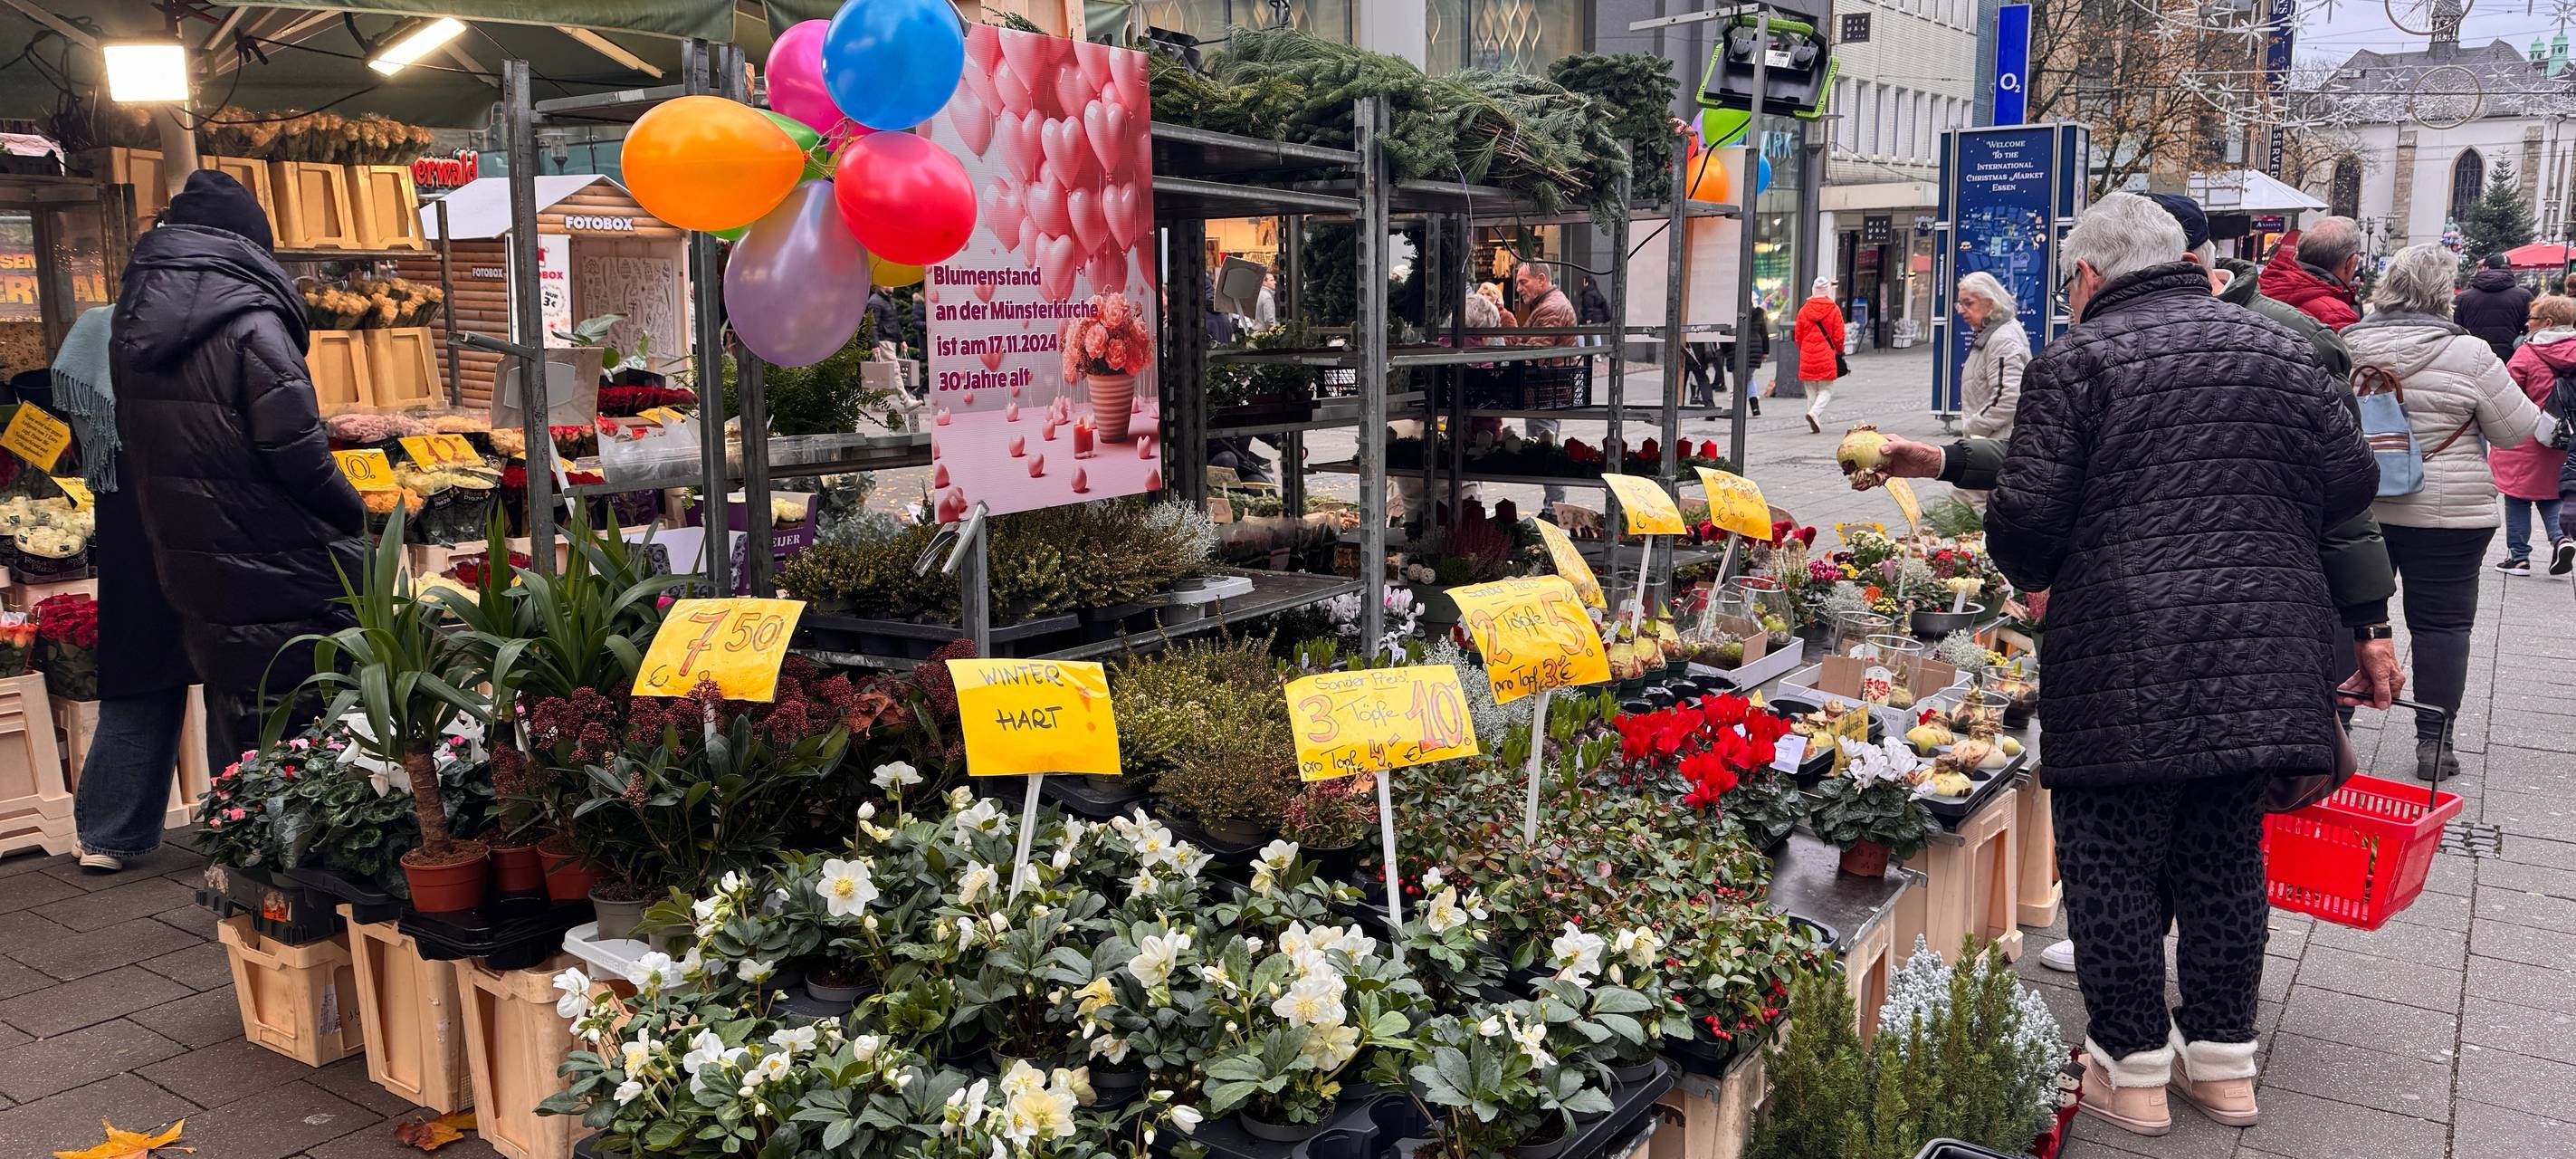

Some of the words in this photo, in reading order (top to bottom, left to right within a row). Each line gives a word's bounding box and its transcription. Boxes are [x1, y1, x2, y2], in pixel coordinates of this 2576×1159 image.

[2270, 123, 2282, 177] ESERVED
[410, 149, 478, 187] erwald
[565, 216, 634, 231] FOTOBOX
[472, 267, 504, 279] FOTOBOX
[539, 271, 564, 280] BOX
[933, 265, 1041, 285] Blumenstand
[936, 304, 957, 321] an
[959, 301, 987, 321] der
[990, 299, 1098, 320] Münsterkirche
[937, 336, 957, 356] ist
[960, 340, 987, 355] am
[988, 334, 1057, 354] 17.11.2024
[939, 372, 960, 391] 30
[964, 369, 1007, 389] Jahre
[1009, 368, 1030, 387] alt
[1470, 608, 1513, 667] 2
[978, 663, 1064, 687] WINTER
[1494, 680, 1514, 700] pro
[1511, 664, 1538, 694] Topf
[996, 705, 1064, 732] HART
[1298, 694, 1340, 742] 3
[1335, 695, 1399, 728] Töpfe
[1302, 761, 1323, 779] pro
[1321, 744, 1357, 775] Topf
